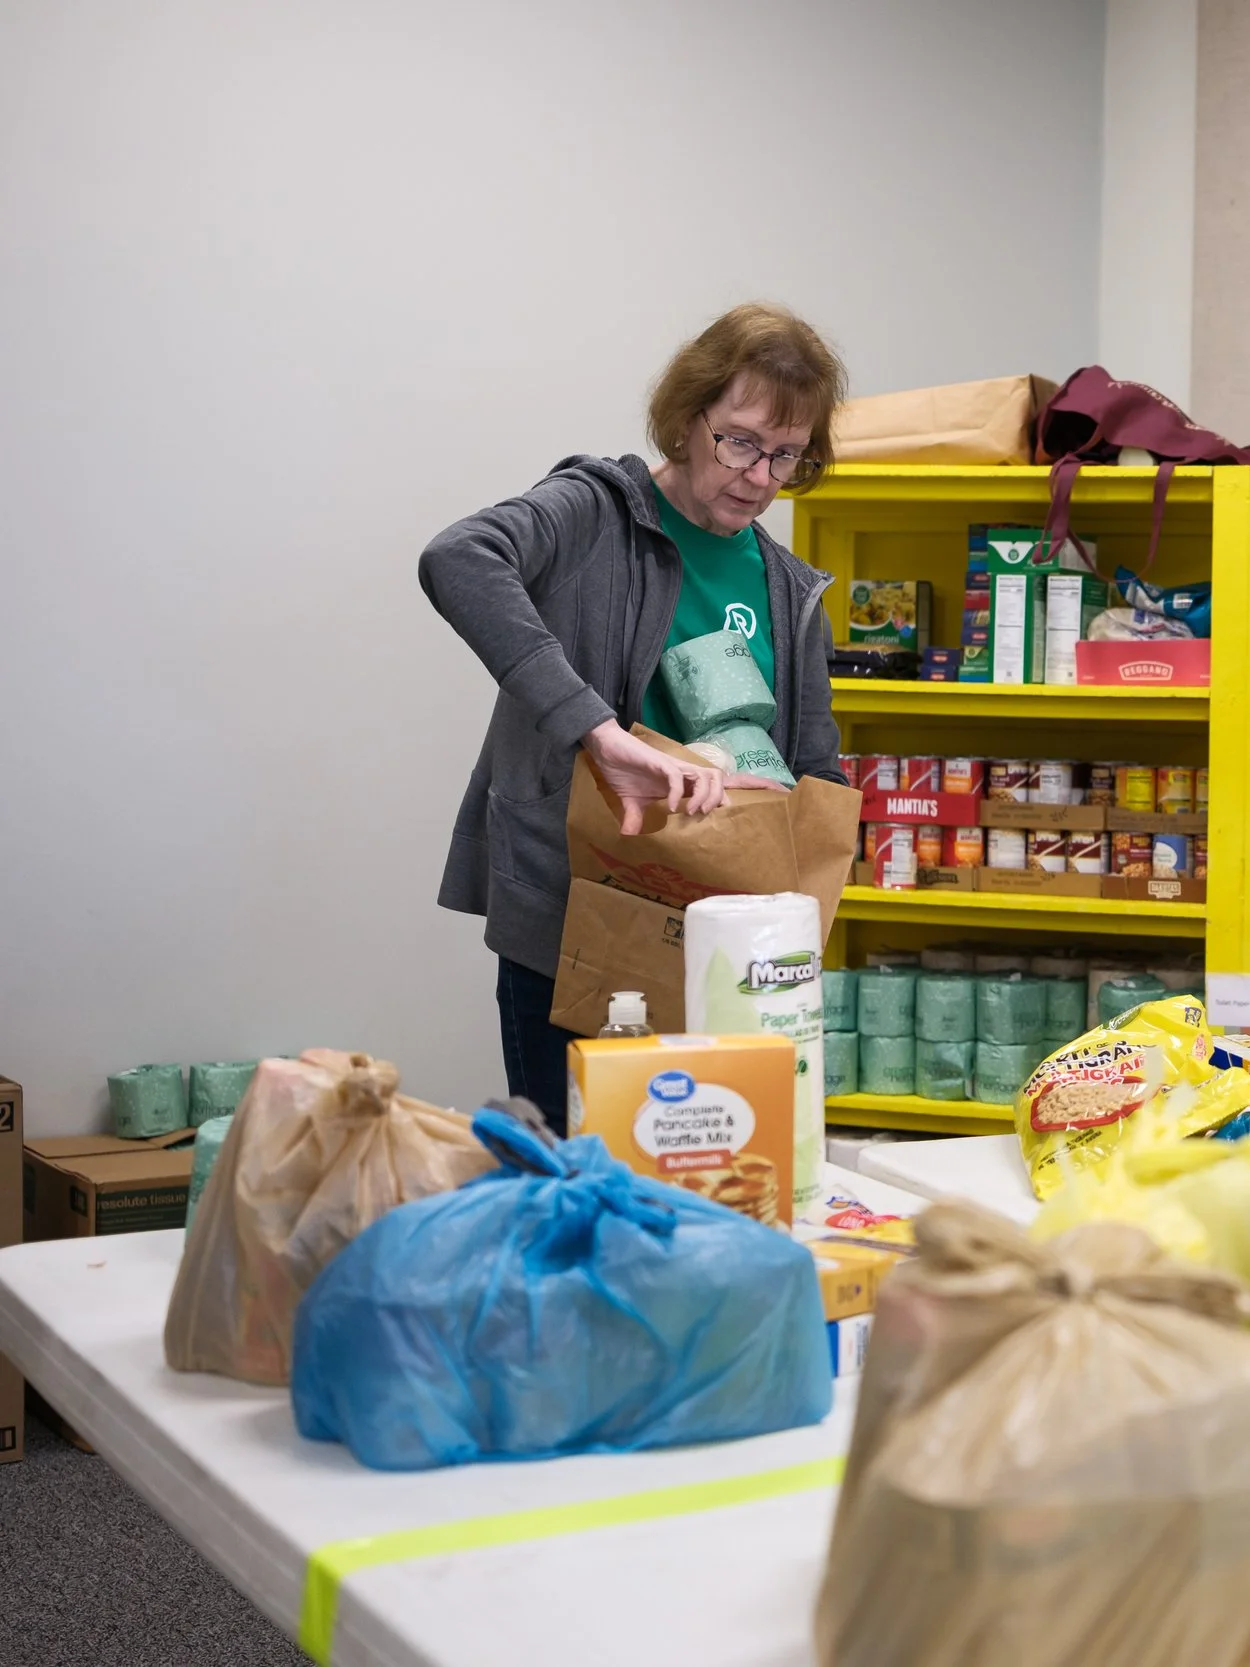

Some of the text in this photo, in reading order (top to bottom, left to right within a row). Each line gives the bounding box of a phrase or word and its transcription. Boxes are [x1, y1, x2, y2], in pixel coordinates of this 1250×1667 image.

[735, 749, 776, 769] green
[886, 796, 939, 818] MANTIA'S
[760, 1010, 798, 1028] Paper
[663, 1105, 724, 1118] Complete
[653, 1115, 735, 1132] Pancake &
[655, 1132, 732, 1148] Waffle Mix
[665, 1154, 723, 1169] Buttermilk
[97, 1195, 148, 1211] resolute
[149, 1191, 187, 1206] tissue
